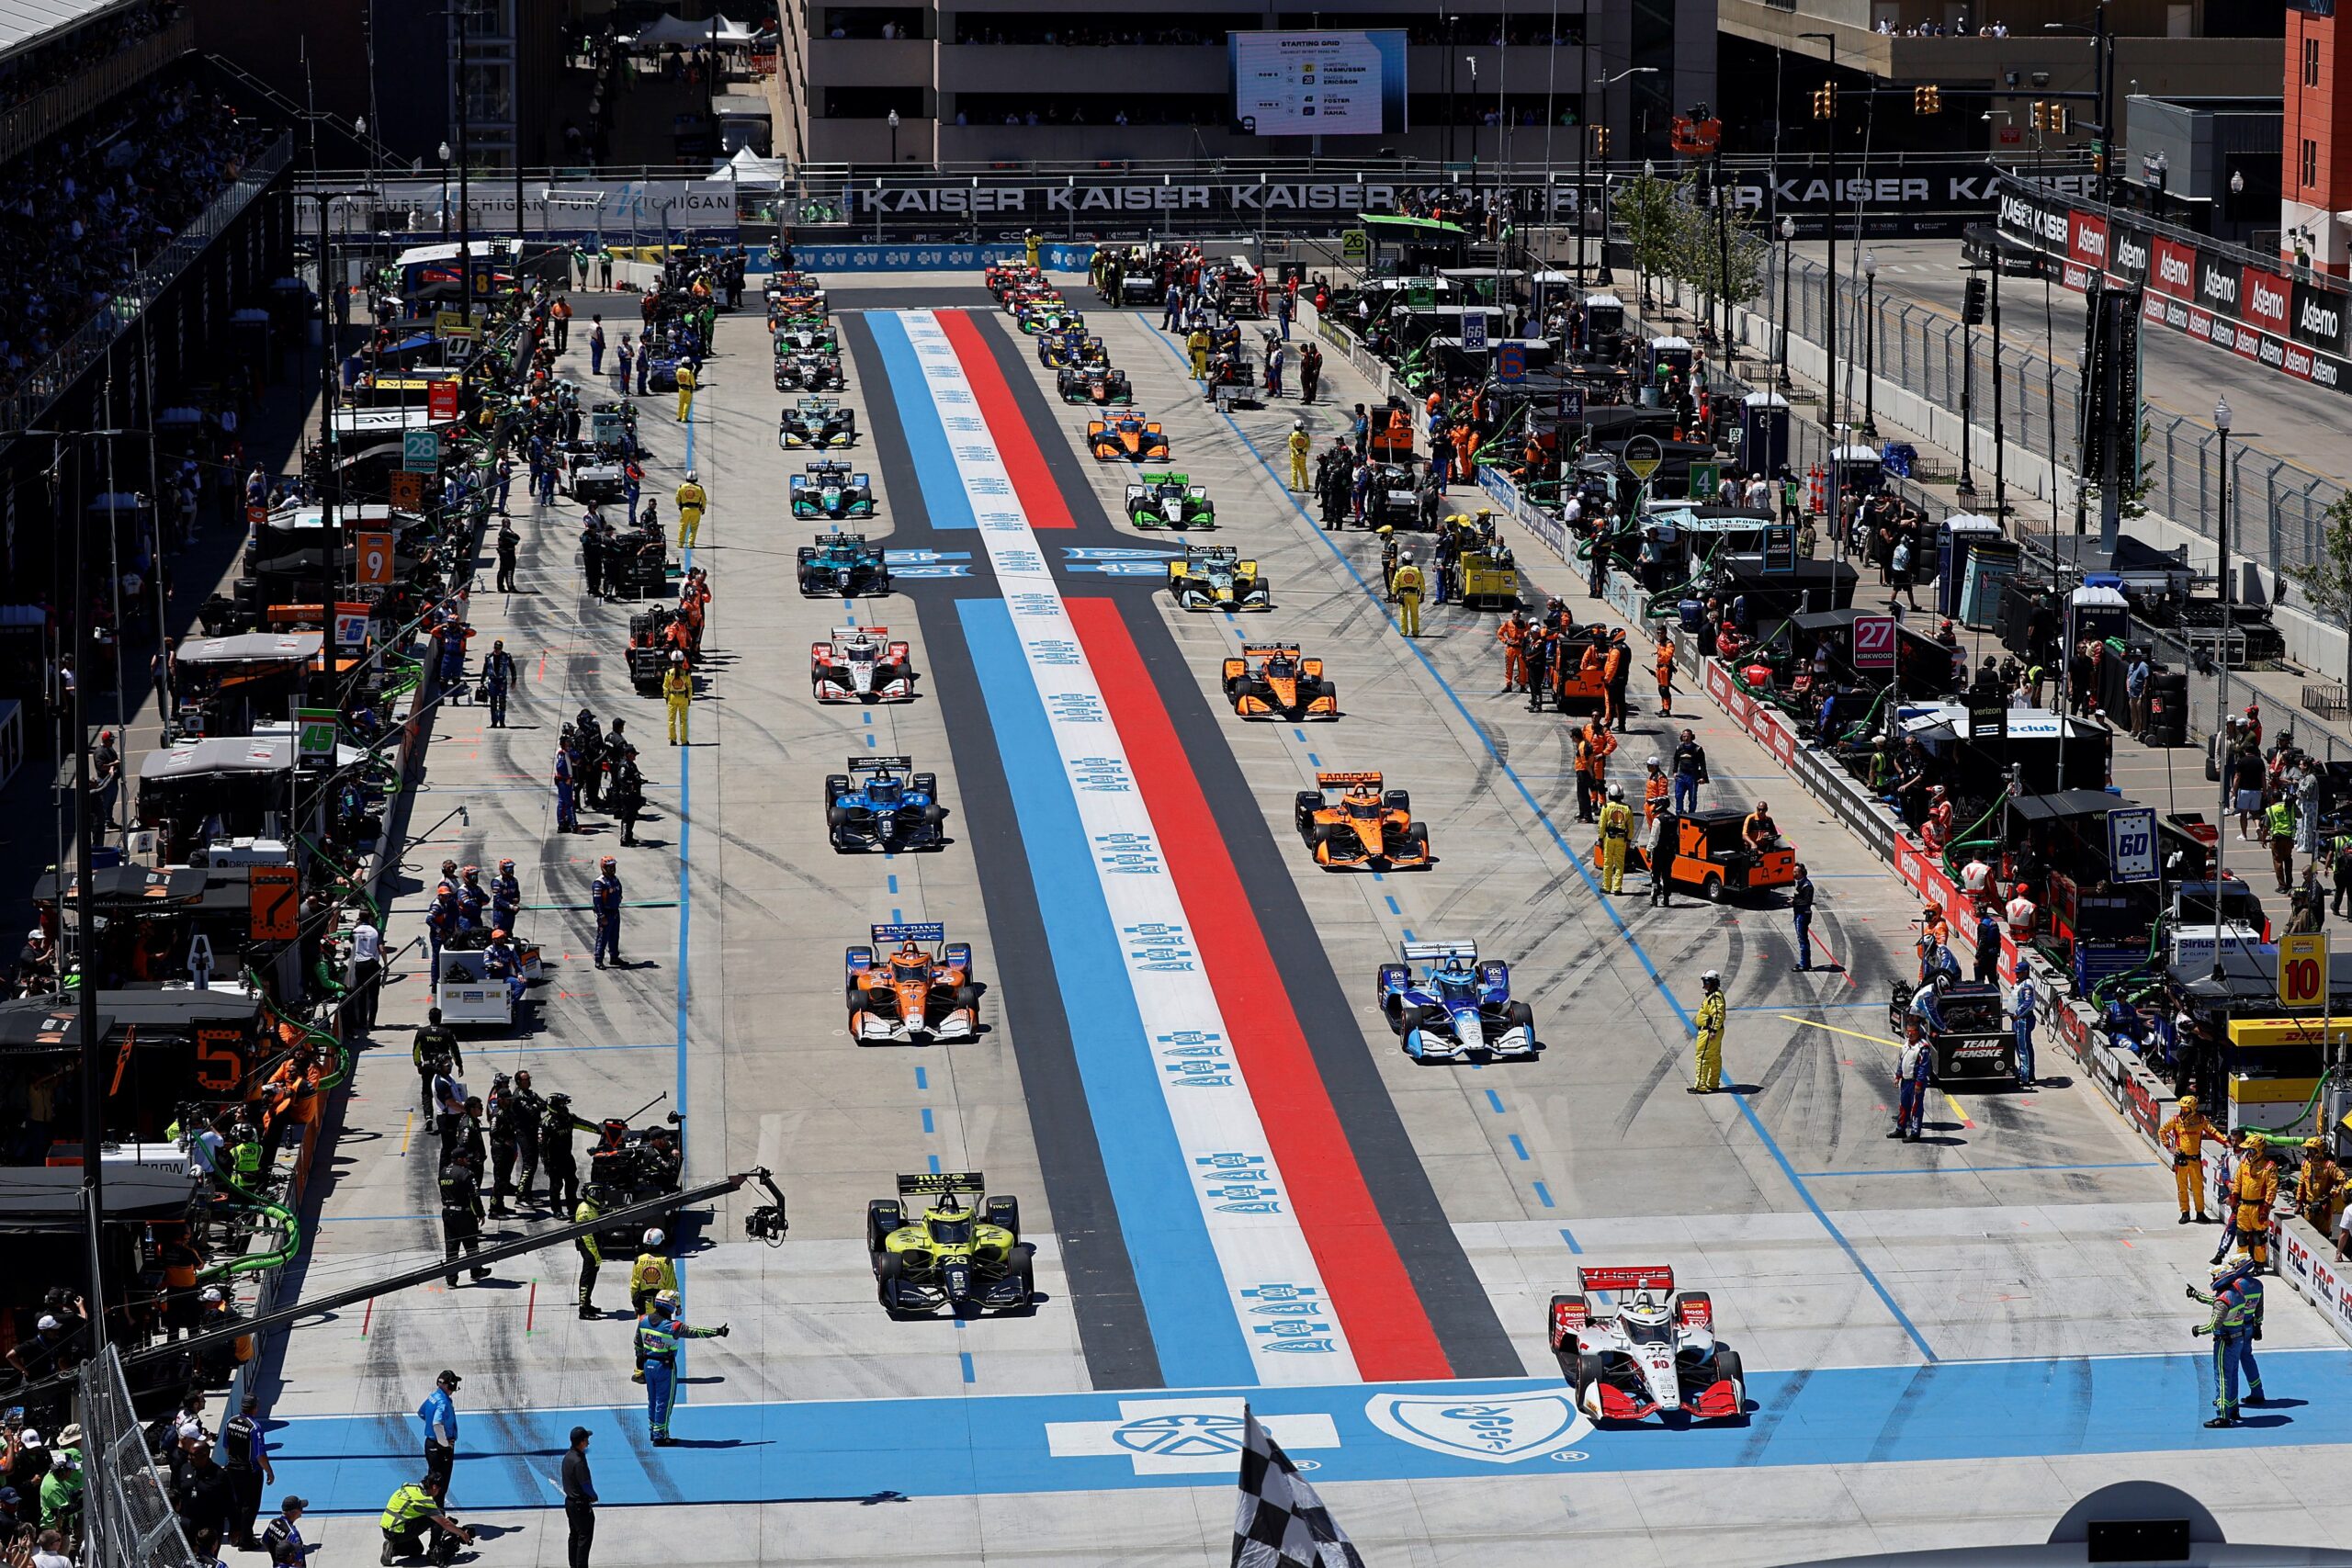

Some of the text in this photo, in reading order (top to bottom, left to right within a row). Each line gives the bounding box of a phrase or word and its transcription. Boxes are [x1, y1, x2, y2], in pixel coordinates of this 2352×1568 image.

[375, 198, 424, 212] PURE
[862, 178, 1929, 212] KAISER KAISER KAISER KAISER
[1344, 233, 1363, 248] 26
[2078, 223, 2104, 257] Astemo
[2118, 236, 2146, 269] Astemo
[2064, 265, 2086, 288] Astemo
[2160, 250, 2188, 287] Astemo
[476, 274, 488, 293] 8
[2204, 265, 2235, 303] Astemo
[2145, 295, 2165, 320] Astemo
[2251, 280, 2284, 321] Astemo
[2166, 302, 2187, 329] Astemo
[2188, 310, 2211, 337] Astemo
[2301, 297, 2338, 338] Astemo
[1466, 325, 1482, 339] 66
[2211, 320, 2234, 347] Astemo
[2235, 329, 2258, 356] Astemo
[448, 338, 468, 354] 47
[2259, 337, 2283, 366] Astemo
[1500, 347, 1522, 379] 6
[2284, 346, 2310, 376] Astemo
[2311, 356, 2337, 386] Astemo
[1562, 397, 1577, 413] 14
[406, 437, 435, 457] 28
[1696, 470, 1712, 492] 4
[368, 550, 384, 579] 9
[1858, 622, 1892, 649] 27
[1857, 651, 1893, 660] KIRKWOOD
[1973, 706, 2002, 716] verizon
[301, 725, 334, 751] 45
[2020, 724, 2058, 732] club
[876, 809, 895, 818] 27
[2119, 832, 2149, 857] 60
[1901, 850, 1920, 884] verizon
[1928, 875, 1948, 916] verizon
[2284, 958, 2321, 1001] 10
[1462, 1010, 1474, 1019] 3
[1962, 1039, 2000, 1048] TEAM
[2284, 1031, 2334, 1042] DHL
[197, 1030, 241, 1090] 5
[1952, 1048, 2004, 1058] PENSKE
[2092, 1034, 2120, 1081] SiriusXM
[944, 1256, 967, 1265] 26
[1609, 1269, 1669, 1280] Honda
[1651, 1359, 1669, 1369] 10
[228, 1422, 249, 1433] INDYCAR
